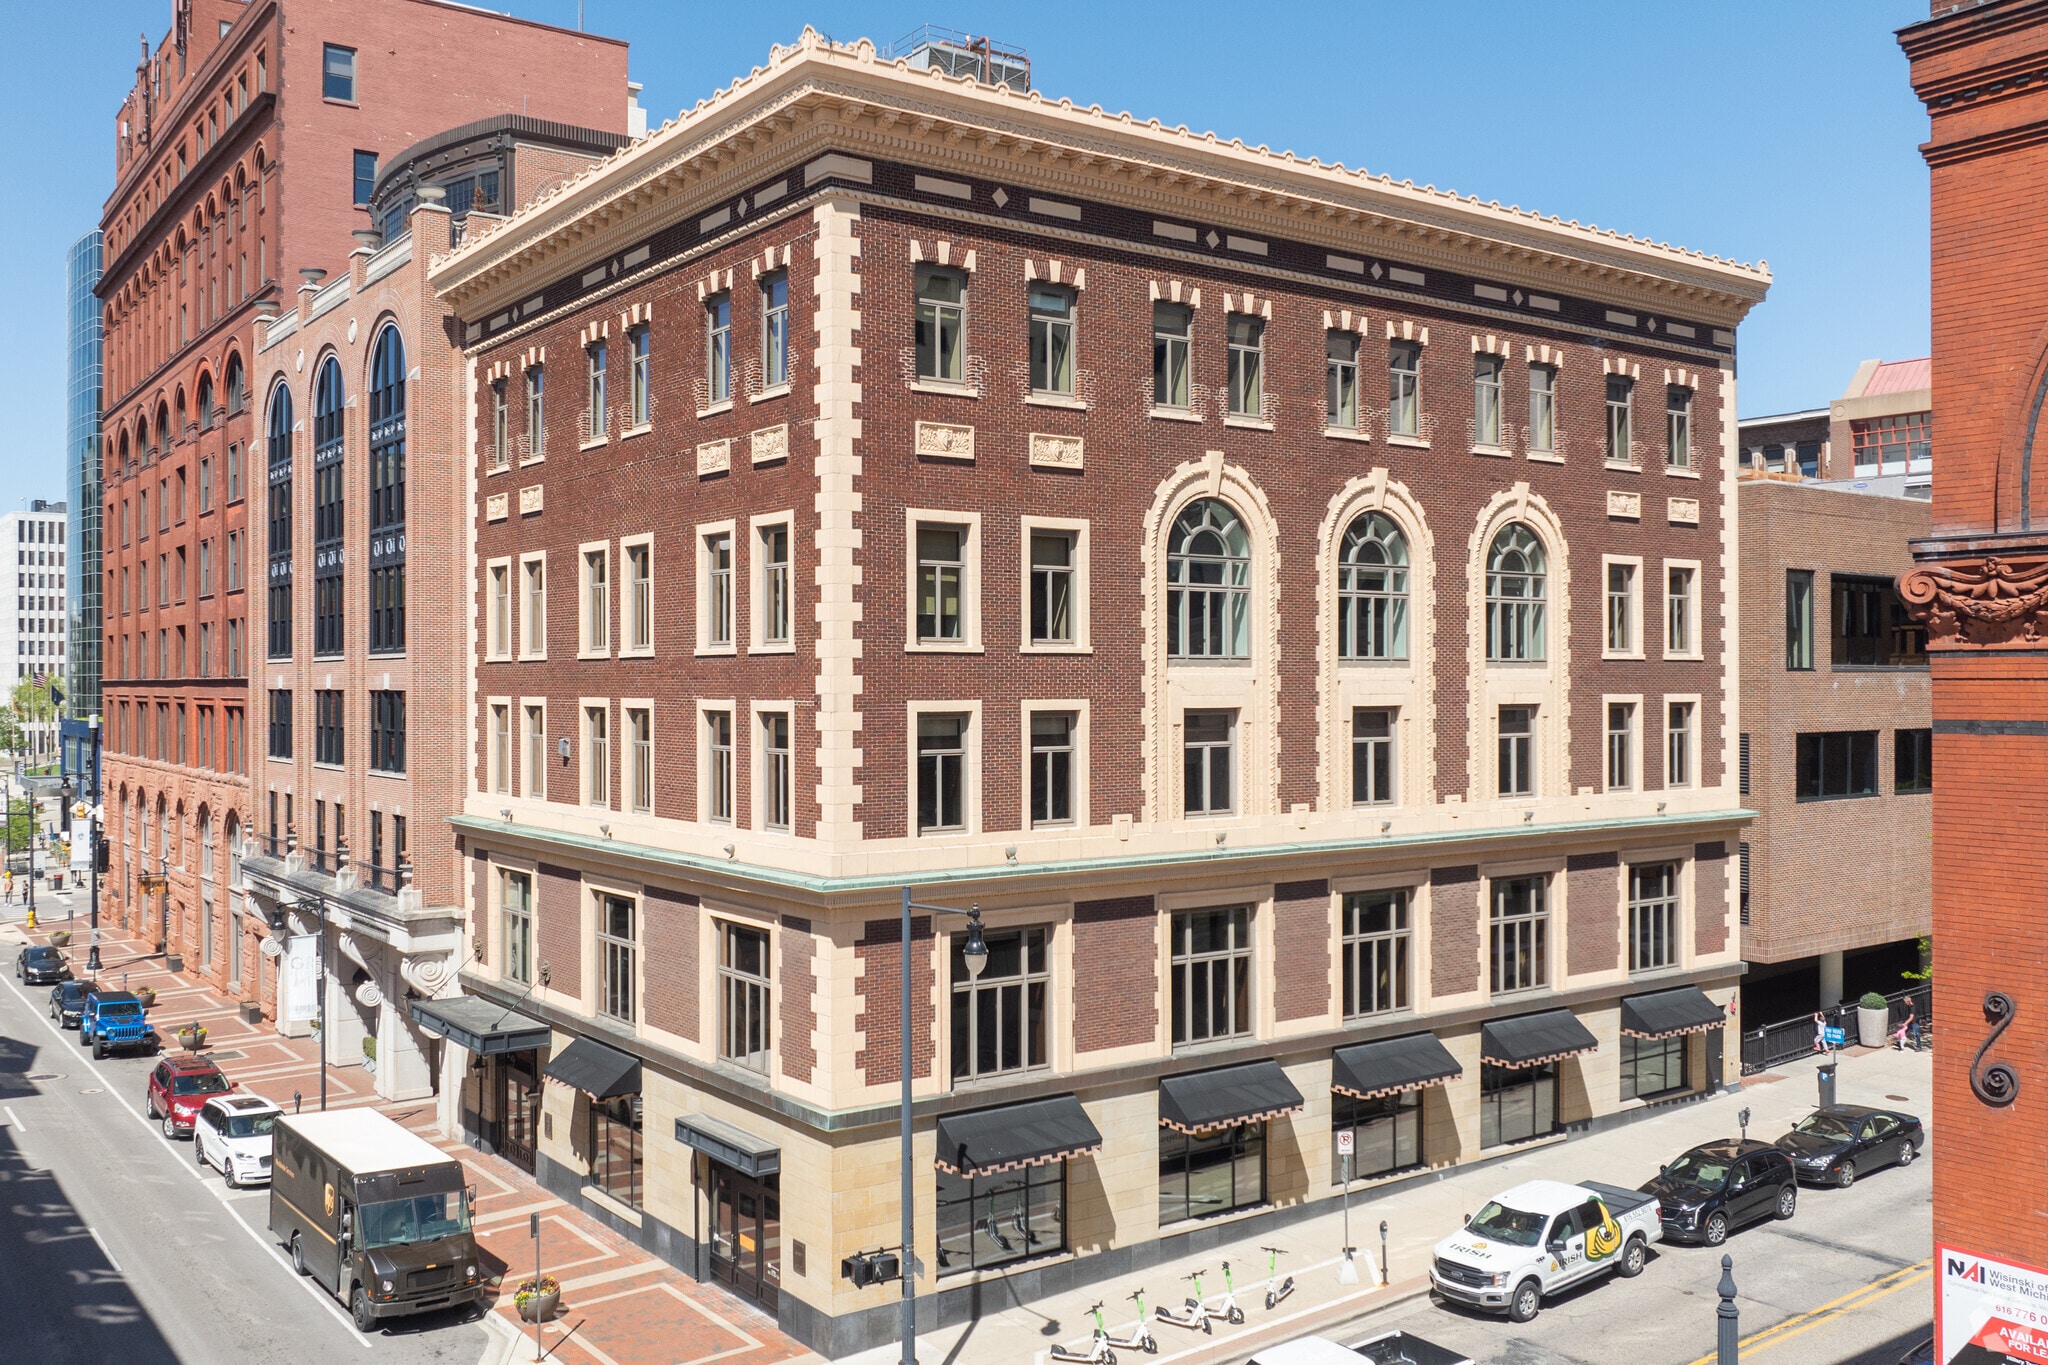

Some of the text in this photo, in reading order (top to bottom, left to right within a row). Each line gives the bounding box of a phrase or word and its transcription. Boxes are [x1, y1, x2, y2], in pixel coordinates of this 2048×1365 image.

[1449, 1243, 1492, 1259] IRISH
[1559, 1252, 1582, 1267] IRISH
[1948, 1258, 1985, 1284] NAI
[1990, 1269, 2048, 1293] Wisinski of
[1990, 1278, 2016, 1292] West
[1995, 1304, 2012, 1315] 616
[2014, 1307, 2036, 1322] 776
[1999, 1326, 2048, 1350] AVAILA
[2008, 1339, 2048, 1359] FOR LE
